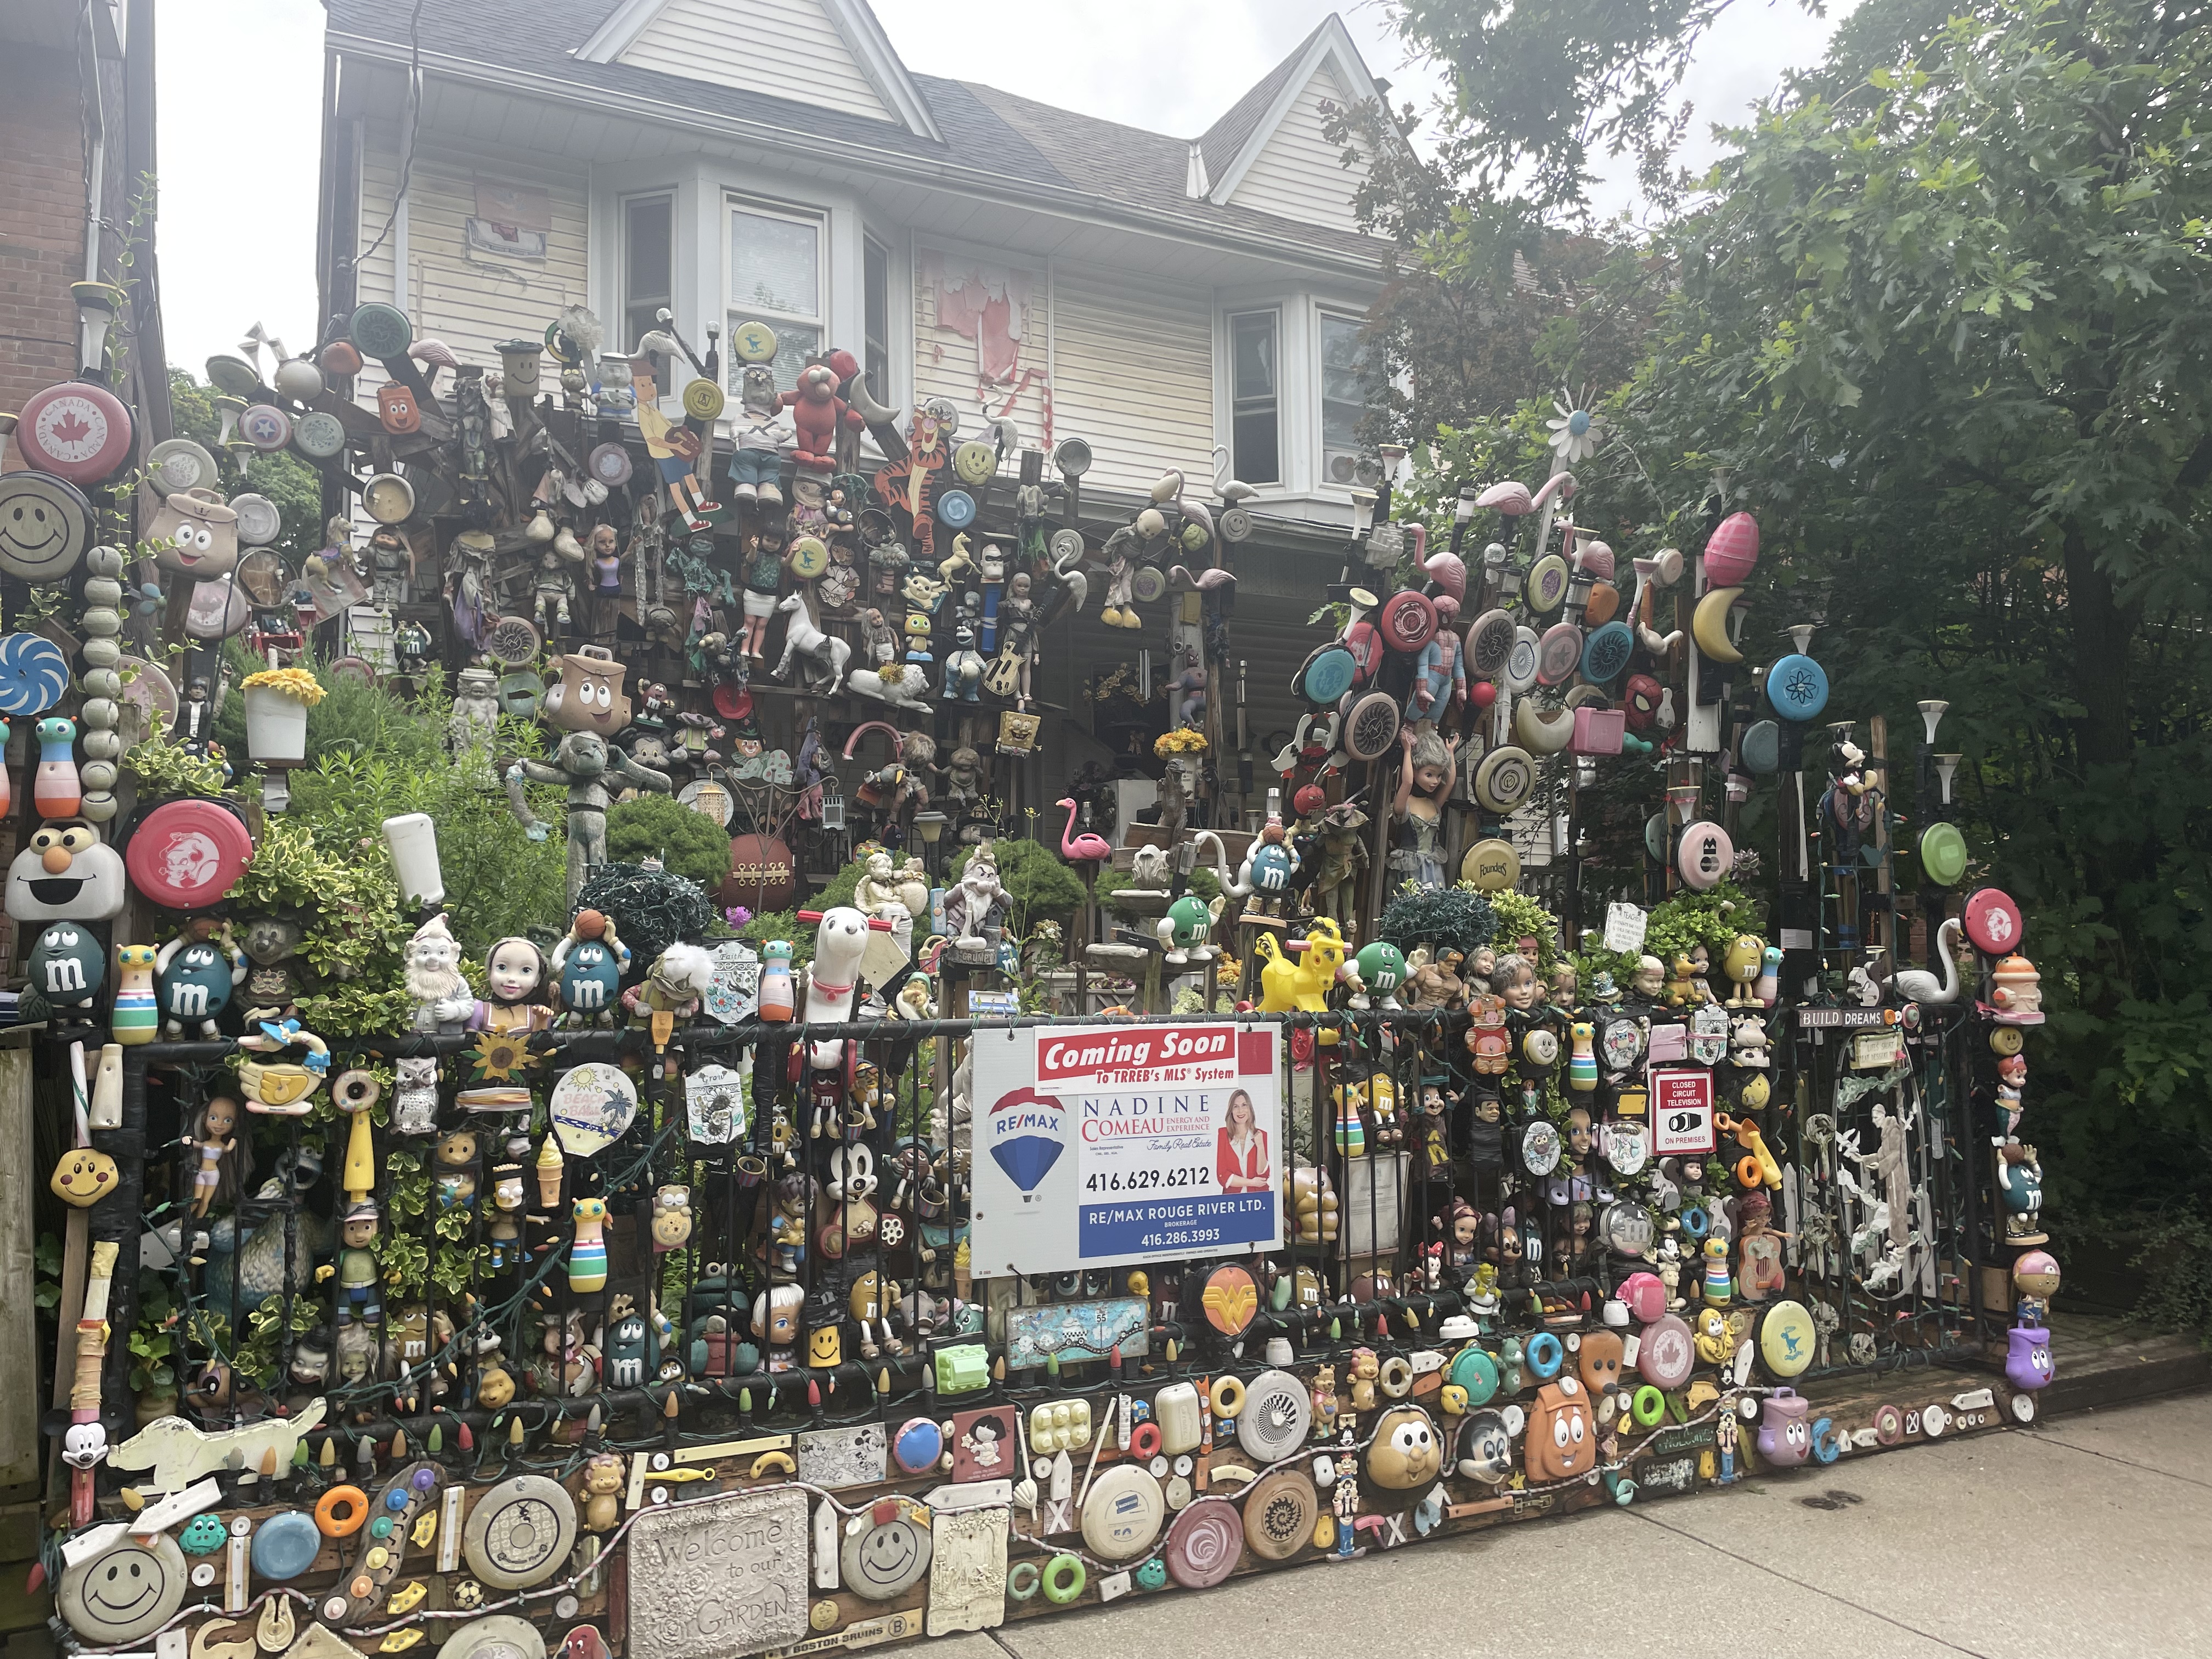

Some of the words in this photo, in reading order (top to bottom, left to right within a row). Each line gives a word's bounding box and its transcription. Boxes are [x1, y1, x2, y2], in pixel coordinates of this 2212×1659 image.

[45, 399, 90, 416] CANADA
[646, 697, 660, 709] m
[1262, 866, 1284, 890] m
[1479, 861, 1507, 879] Founders
[1193, 922, 1207, 940] m
[45, 957, 86, 992] m
[1744, 965, 1758, 977] m
[1375, 972, 1396, 989] m
[171, 982, 209, 1015] m
[572, 979, 605, 1008] m
[1803, 1012, 1839, 1025] BUILD
[1845, 1012, 1881, 1025] DREAMS
[1045, 1037, 1151, 1070] Coming
[1159, 1032, 1227, 1058] Soon
[703, 1075, 725, 1085] Grow
[1097, 1071, 1109, 1084] To
[1114, 1069, 1160, 1083] TRREB's
[1195, 1067, 1234, 1082] System
[563, 1093, 605, 1104] BEACH
[820, 1096, 833, 1107] m
[1084, 1094, 1210, 1118] NADINE
[1379, 1096, 1392, 1110] m
[1667, 1098, 1701, 1107] TELEVISION
[996, 1114, 1058, 1135] RE/MAX
[1081, 1118, 1164, 1142] COMEAU
[1166, 1116, 1193, 1124] ENERGY
[1166, 1124, 1210, 1132] EXPERIENCE
[772, 1142, 785, 1154] m
[1147, 1139, 1172, 1152] Family
[1173, 1138, 1192, 1149] Real
[1192, 1137, 1212, 1147] Estate
[1086, 1167, 1209, 1192] 416.629.6212
[2025, 1189, 2042, 1210] m
[1090, 1209, 1144, 1224] RE/MAX
[1148, 1204, 1193, 1220] ROUGE
[1198, 1201, 1235, 1215] RIVER
[1239, 1199, 1266, 1212] LTD.
[1164, 1219, 1198, 1227] BROKERAGE
[1141, 1228, 1220, 1246] 416.286.3993
[1527, 1237, 1541, 1261] m
[1304, 1287, 1318, 1302] m
[405, 1339, 426, 1358] m
[611, 1357, 644, 1386] m
[653, 1525, 784, 1566] Welcome
[726, 1562, 744, 1578] to
[751, 1559, 781, 1573] our
[697, 1582, 788, 1634] GARDEN
[793, 1637, 839, 1654] BOSTON
[842, 1627, 883, 1643] BRUINS
